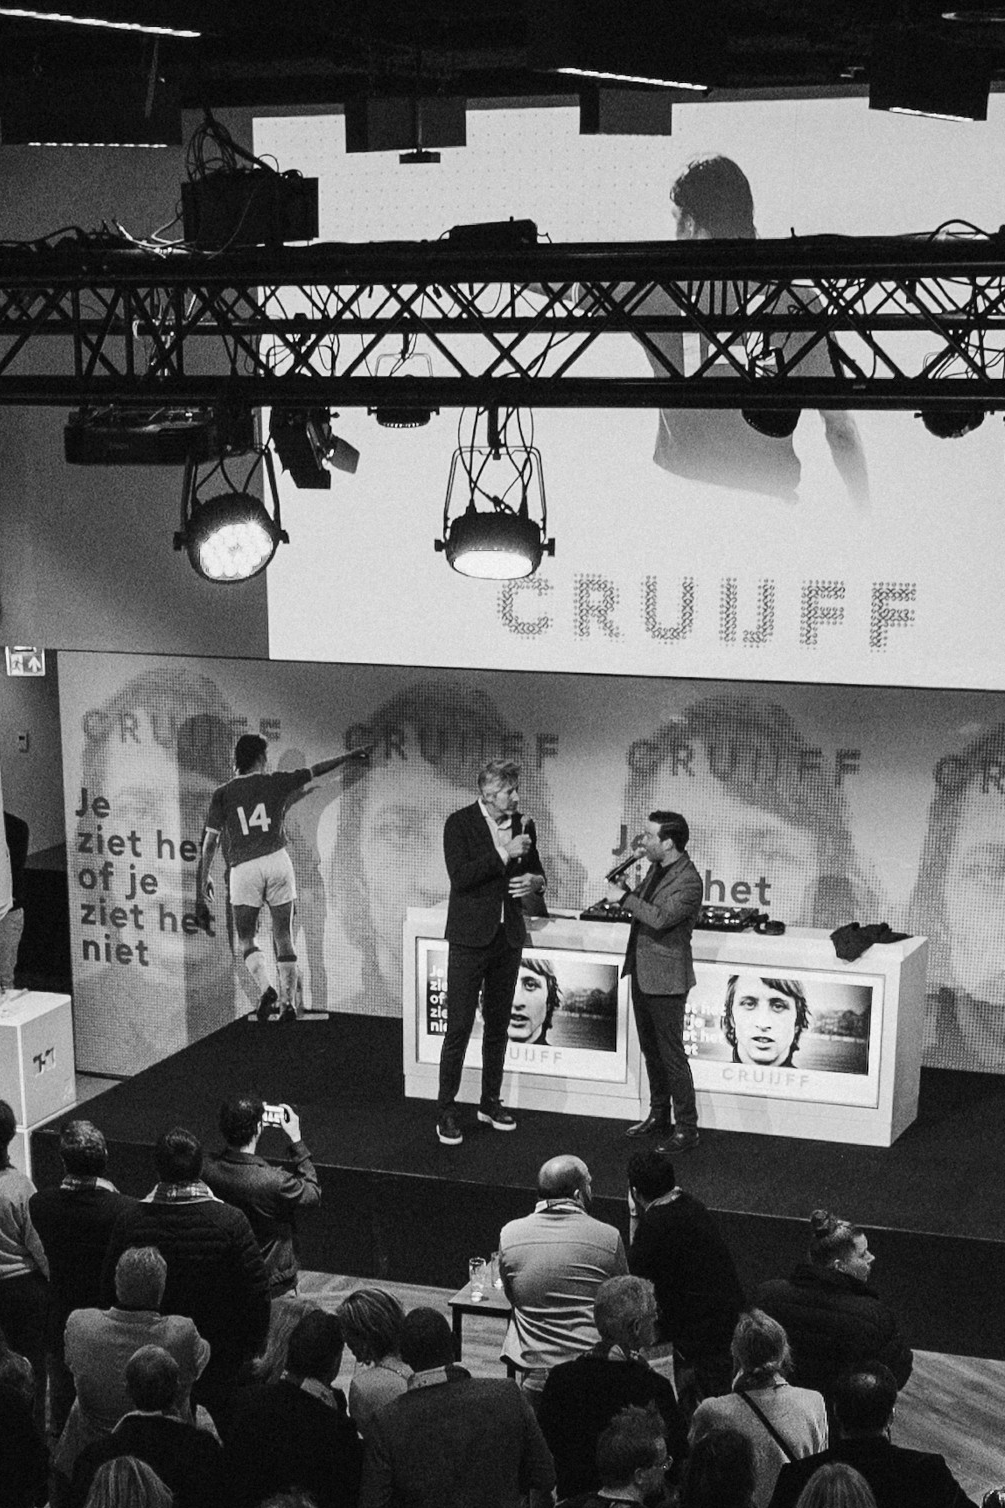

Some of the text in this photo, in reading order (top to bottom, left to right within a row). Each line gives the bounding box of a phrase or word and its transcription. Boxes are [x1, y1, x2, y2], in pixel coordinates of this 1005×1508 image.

[75, 788, 111, 818] Je
[236, 803, 271, 836] 14
[77, 825, 200, 862] ziet he
[79, 861, 158, 900] of je
[705, 869, 771, 906] het
[80, 899, 216, 937] ziet het
[82, 934, 149, 967] niet
[429, 979, 448, 992] zie
[429, 1005, 448, 1019] zie
[430, 1019, 448, 1032] ni
[509, 1047, 562, 1064] UIJFF
[722, 1067, 809, 1088] CRUIJFF
